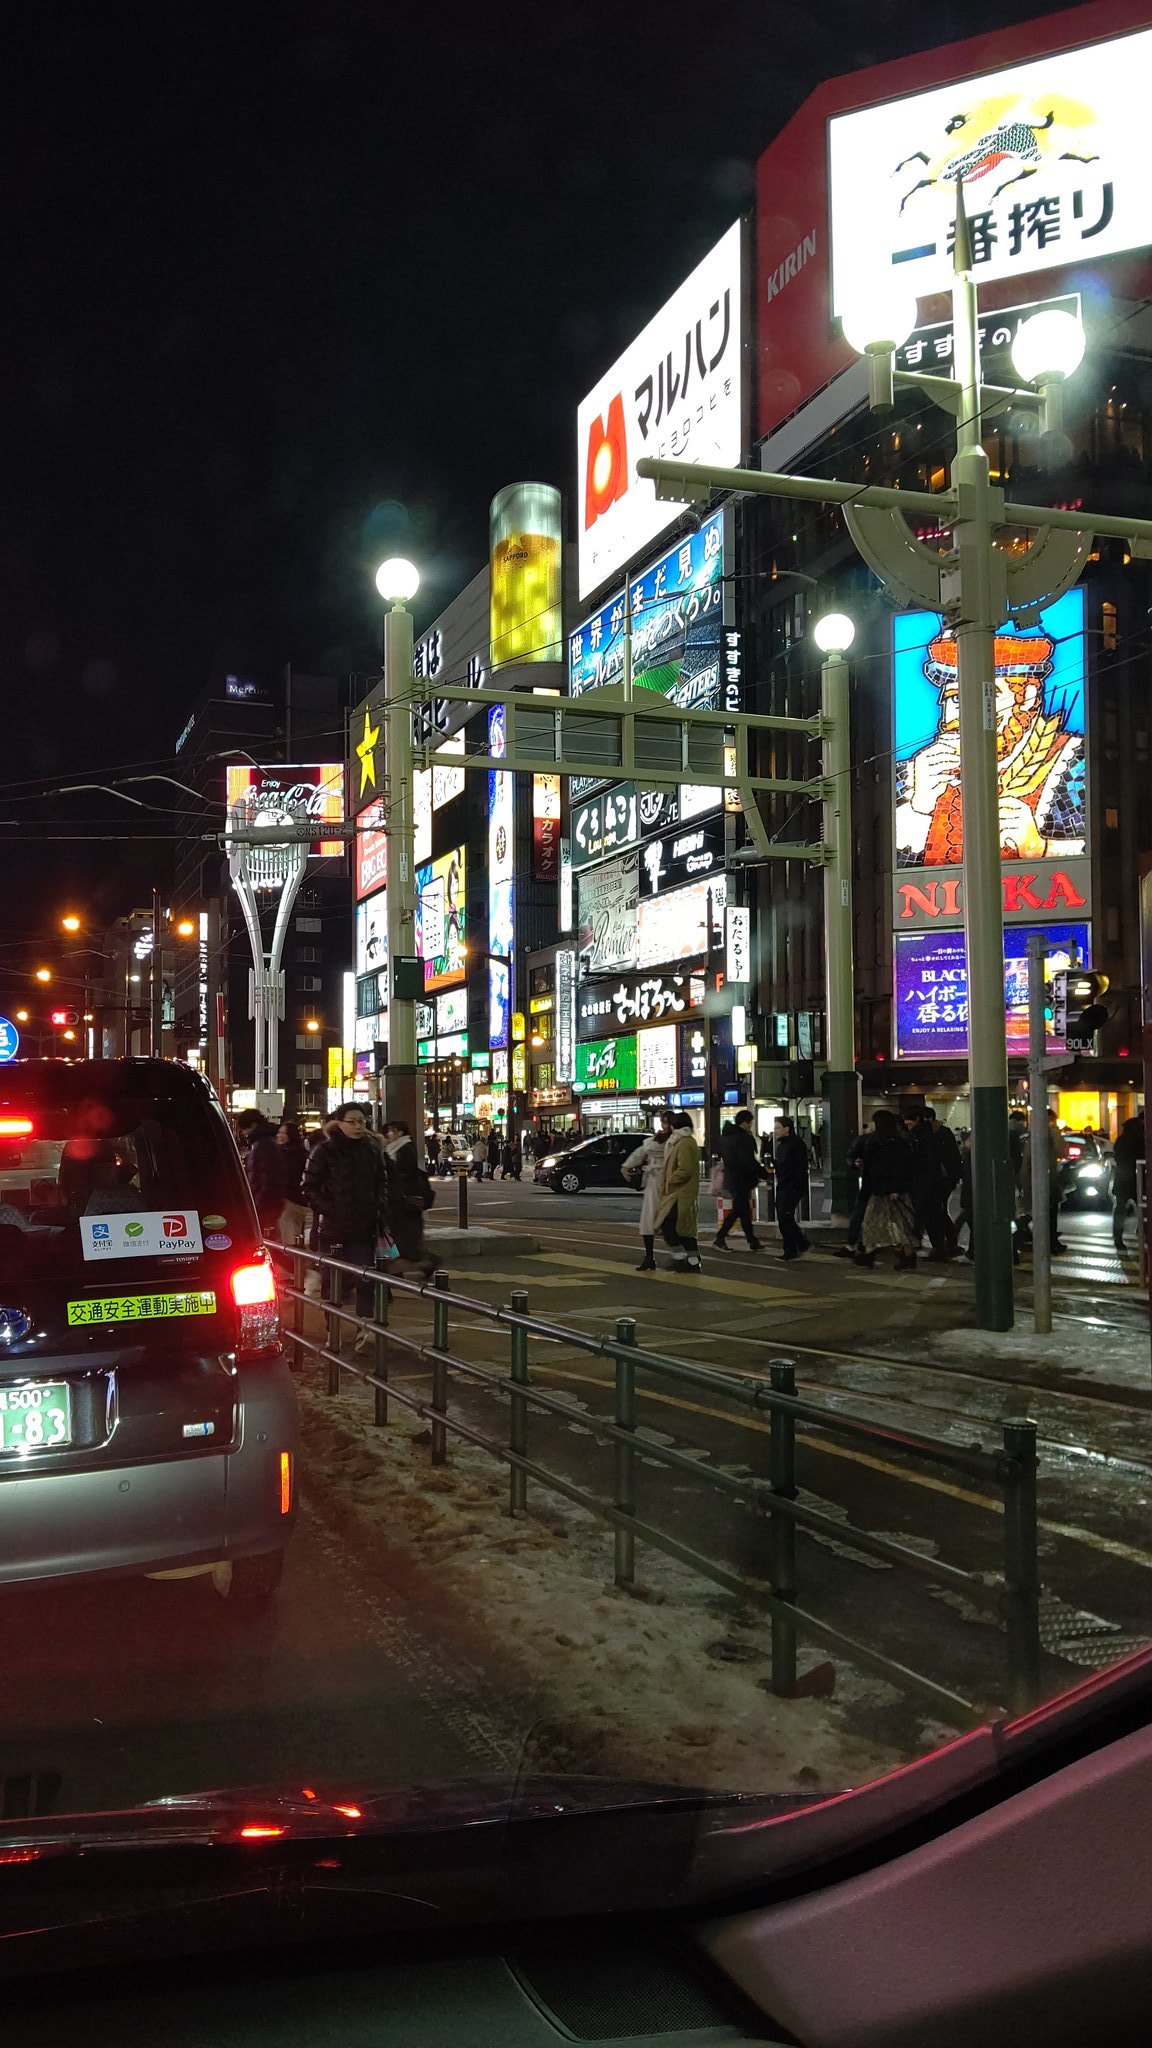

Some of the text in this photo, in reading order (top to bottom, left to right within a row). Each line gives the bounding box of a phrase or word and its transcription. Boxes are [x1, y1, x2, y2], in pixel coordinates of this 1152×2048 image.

[892, 182, 1113, 264] 一番搾り
[767, 229, 816, 303] KIRIN
[635, 288, 730, 440] マルハン
[503, 552, 528, 563] SAPPORO
[572, 574, 721, 699] ボールパクをつくろう。
[229, 685, 269, 696] Mercure
[725, 632, 741, 727] すすきのビ
[241, 783, 338, 815] Coca-Cola
[261, 779, 280, 788] Enjoy
[541, 819, 555, 870] カラオケ
[897, 871, 1086, 918] NIKA
[122, 1240, 149, 1248] 微信支付
[159, 1239, 196, 1249] PayPay
[71, 1293, 214, 1323] 交通安全運動実施中
[0, 1409, 66, 1444] -83
